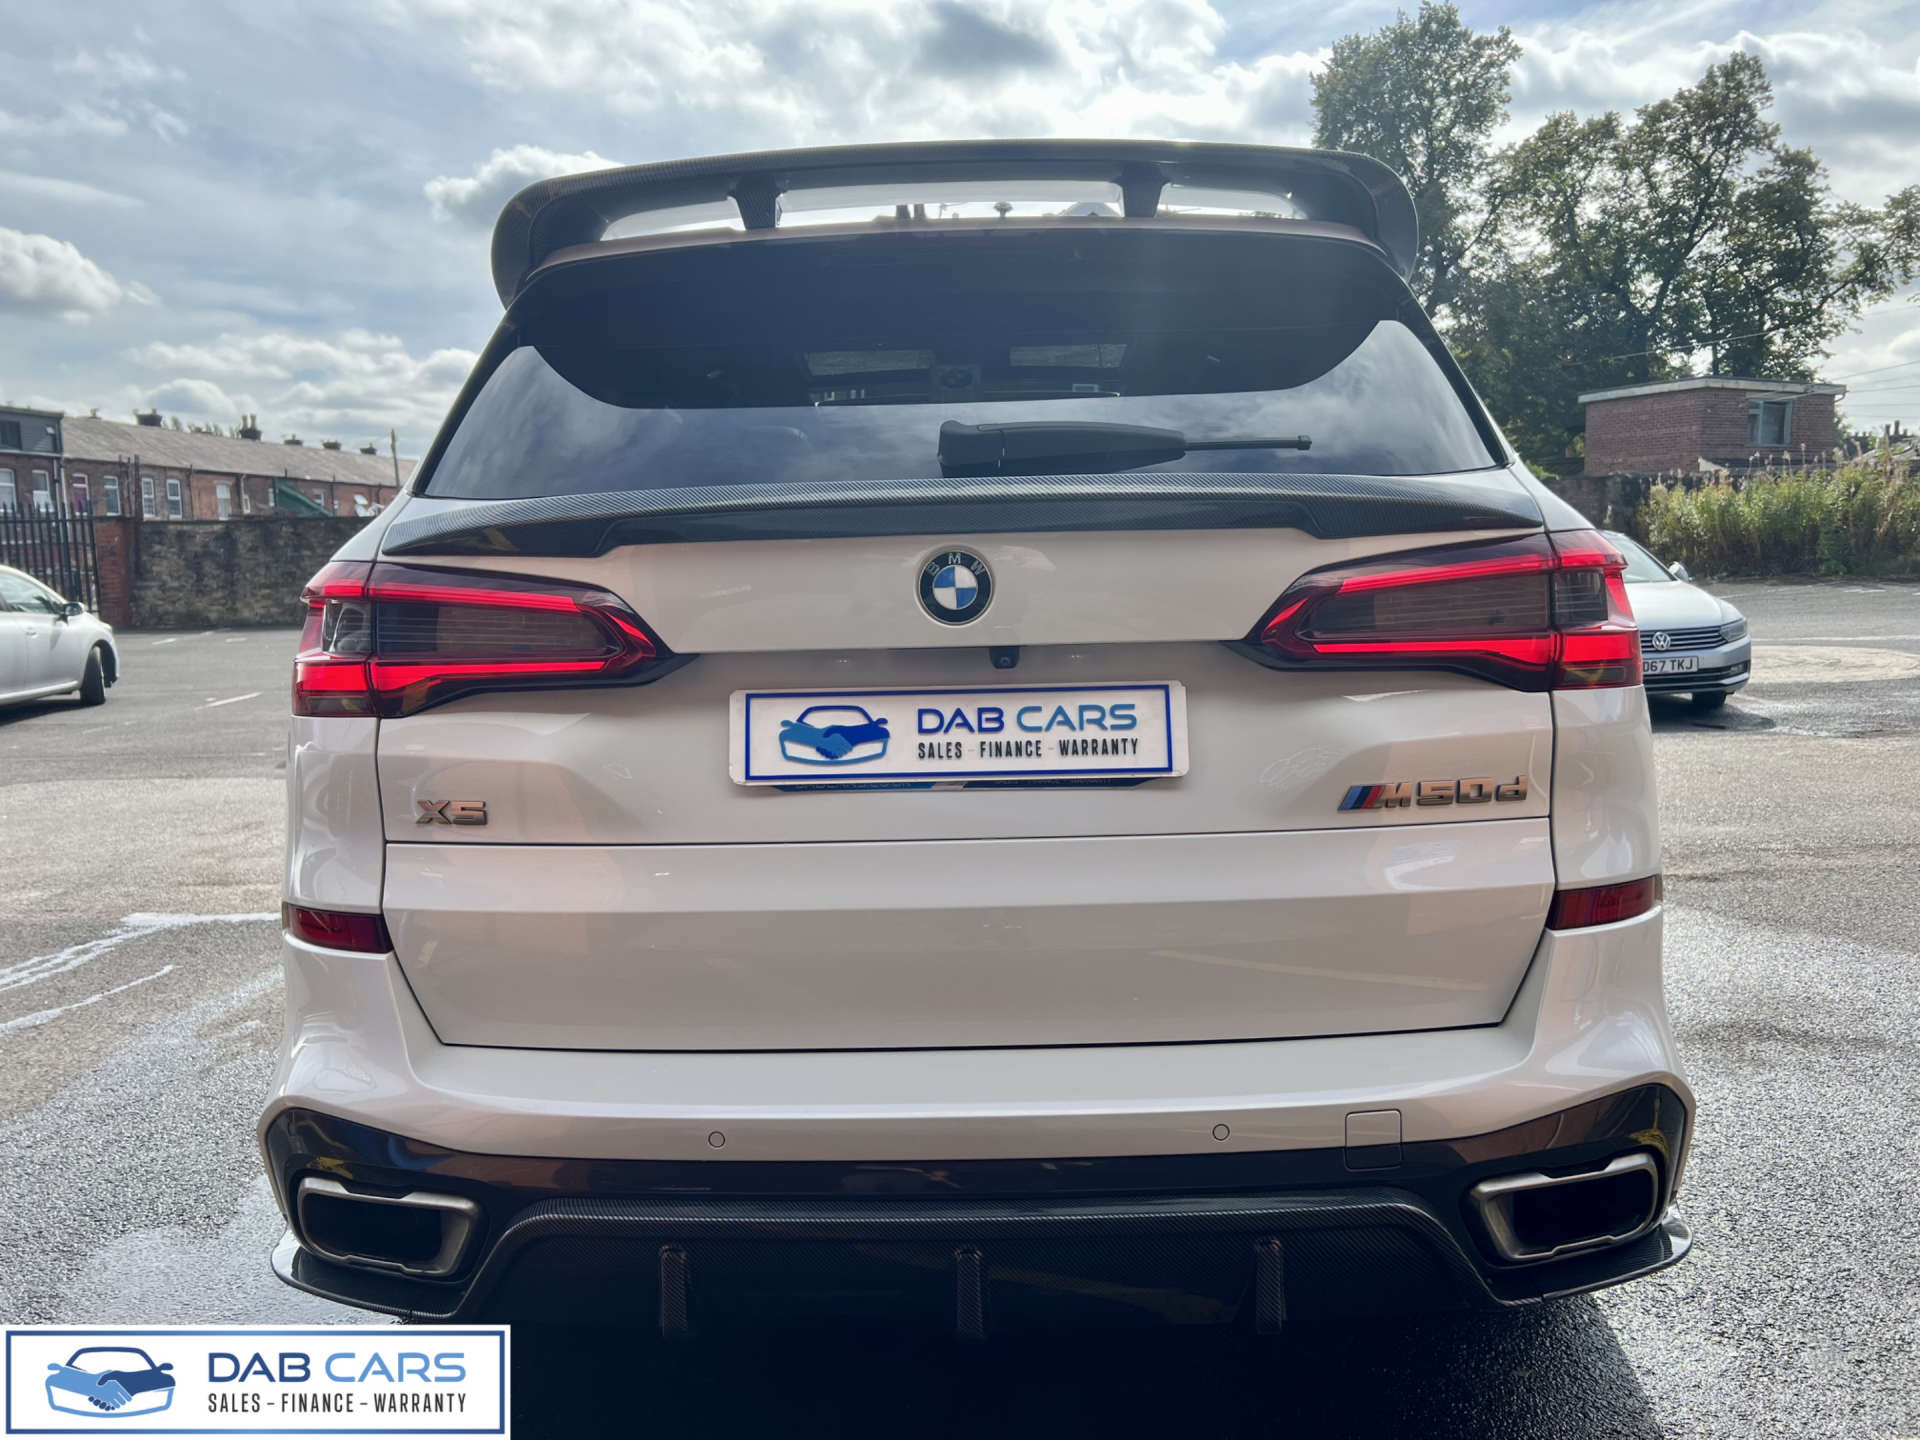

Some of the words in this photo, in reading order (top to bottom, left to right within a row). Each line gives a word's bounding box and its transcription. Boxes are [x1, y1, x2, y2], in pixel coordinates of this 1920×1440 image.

[927, 552, 985, 577] BMW
[1670, 659, 1693, 672] TKJ
[917, 706, 1004, 734] DAB
[1016, 703, 1138, 732] CARS
[917, 742, 963, 760] SALES
[979, 740, 1043, 759] FINANCE
[1058, 738, 1139, 757] WARRANTY
[1371, 775, 1528, 809] M50d
[415, 800, 487, 825] X5
